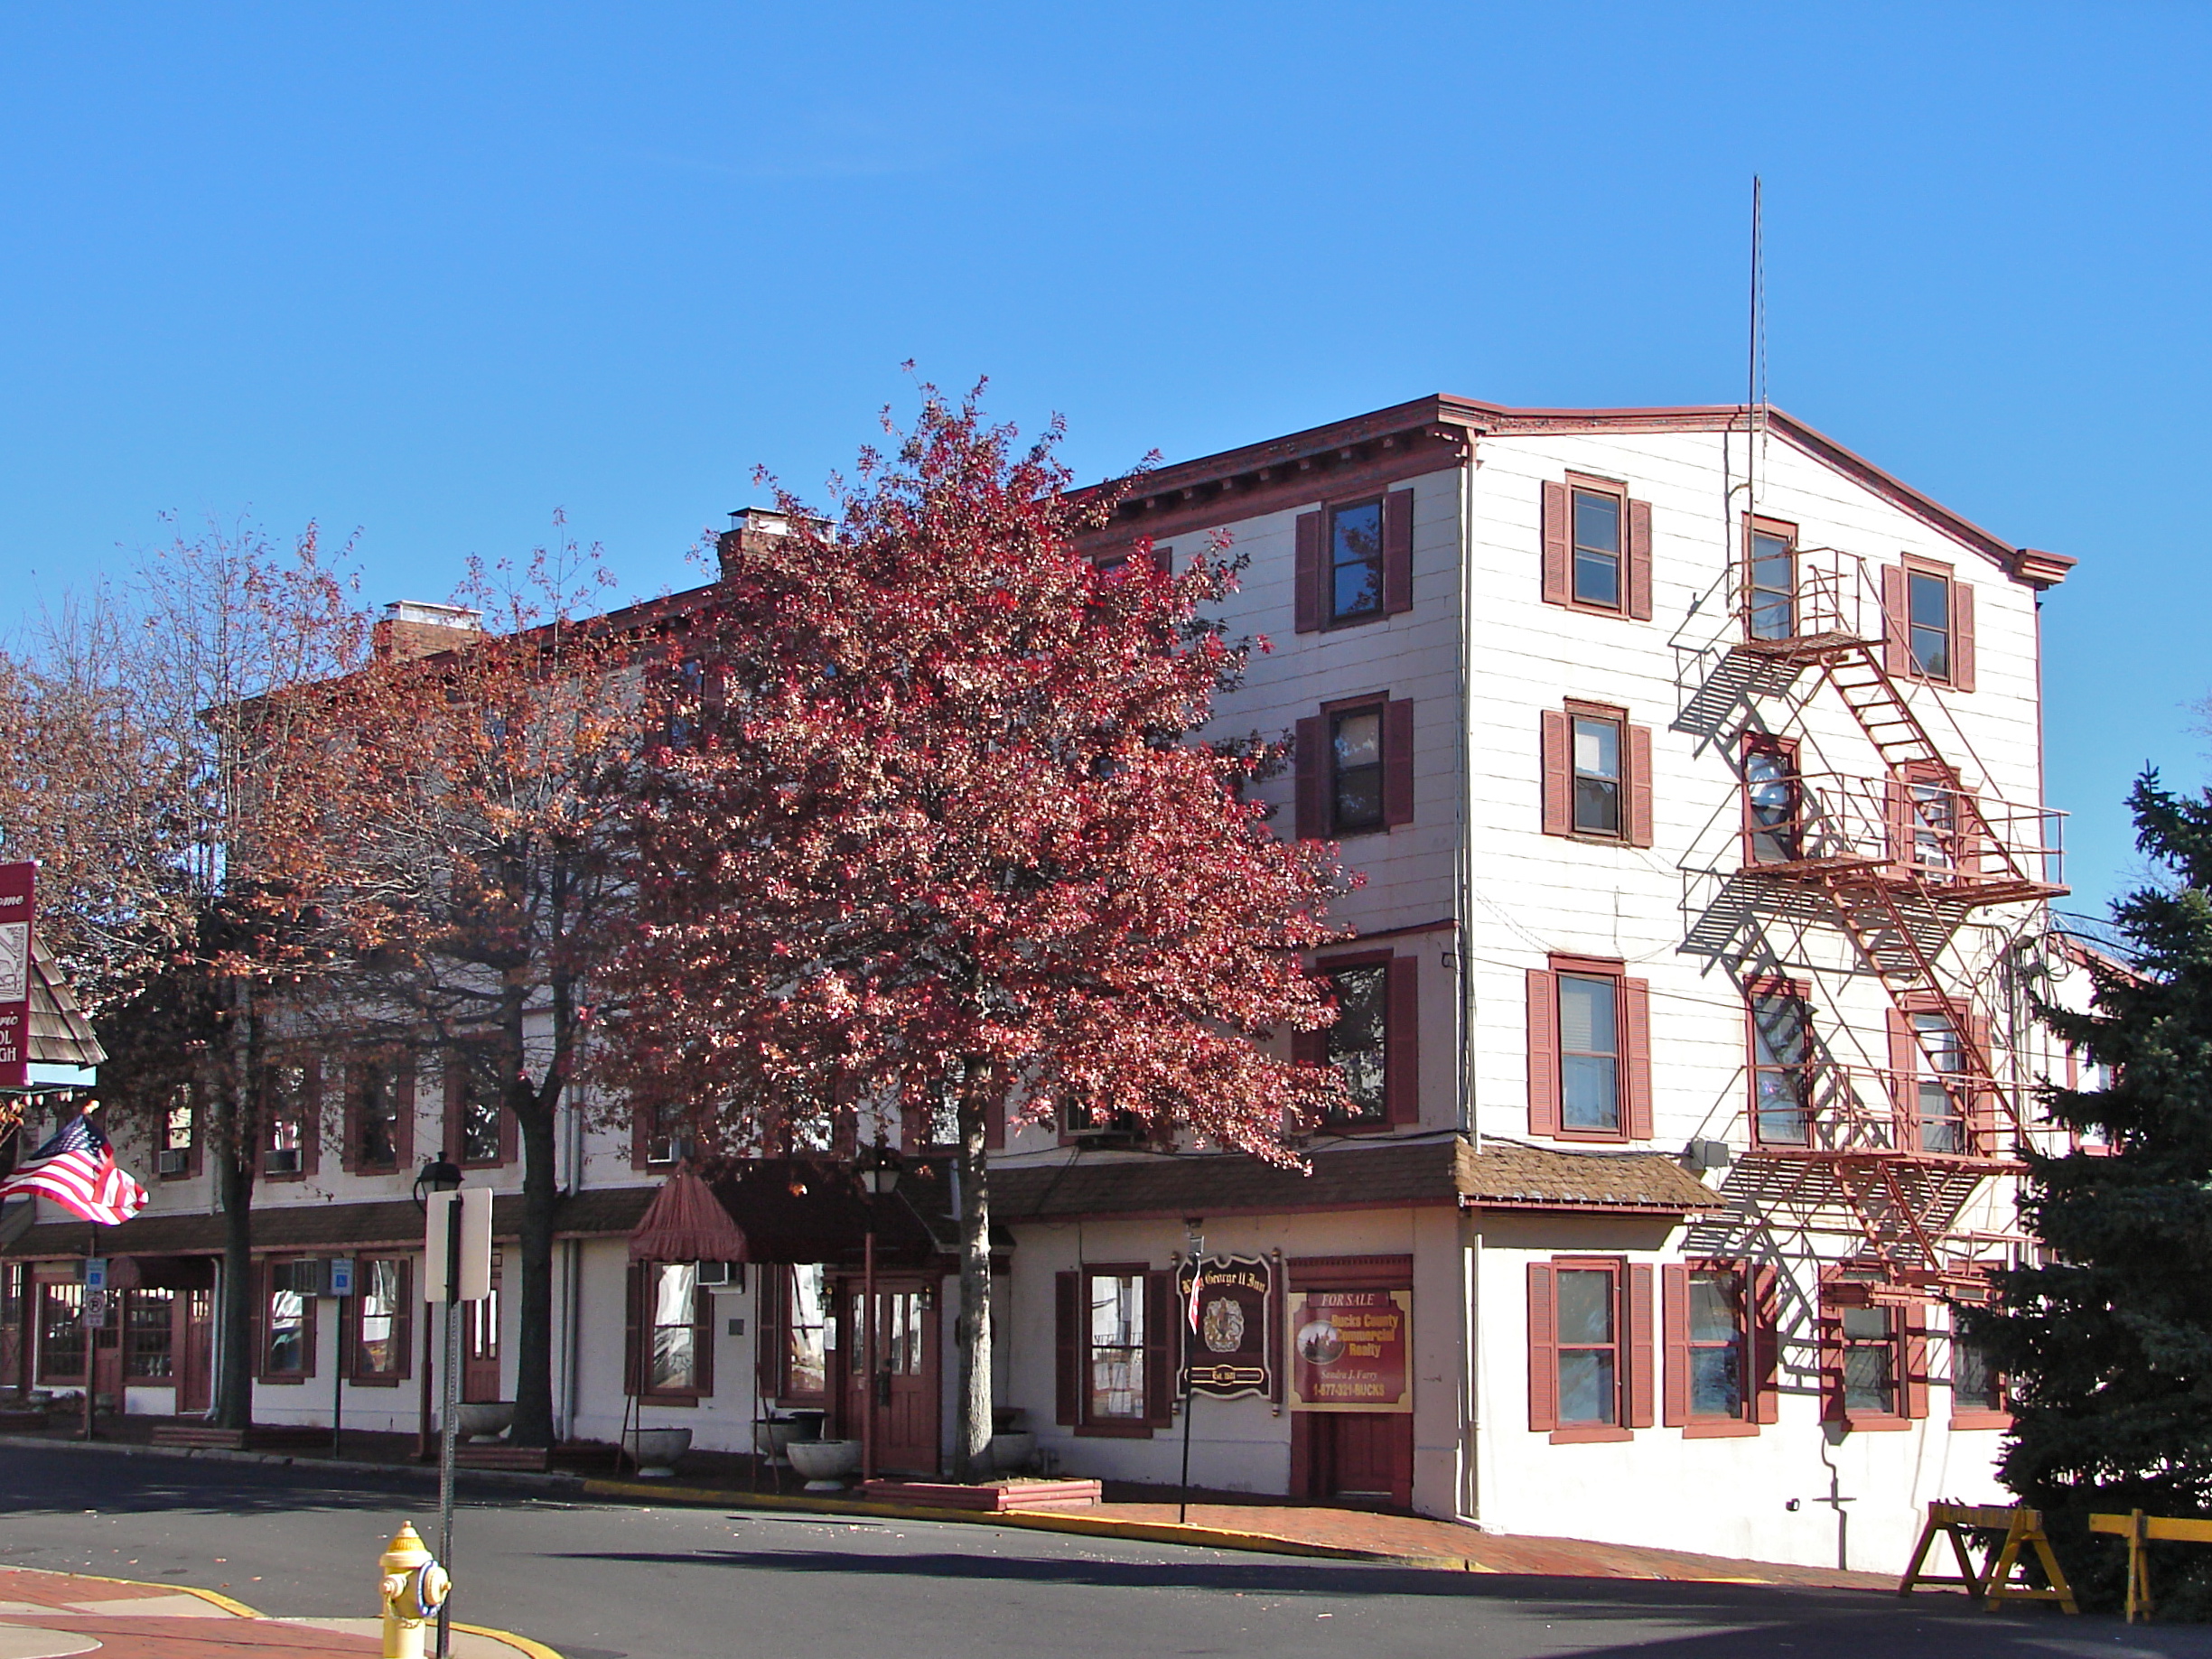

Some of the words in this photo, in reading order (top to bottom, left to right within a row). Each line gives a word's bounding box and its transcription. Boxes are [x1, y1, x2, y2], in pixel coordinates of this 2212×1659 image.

[1205, 1270, 1237, 1287] George
[1246, 1272, 1265, 1293] Inn
[1321, 1293, 1345, 1307] FOR
[1347, 1293, 1376, 1306] SALE
[1331, 1314, 1361, 1328] Bucks
[1364, 1314, 1399, 1328] County
[1336, 1328, 1395, 1342] Commercial
[1349, 1343, 1381, 1358] Realty
